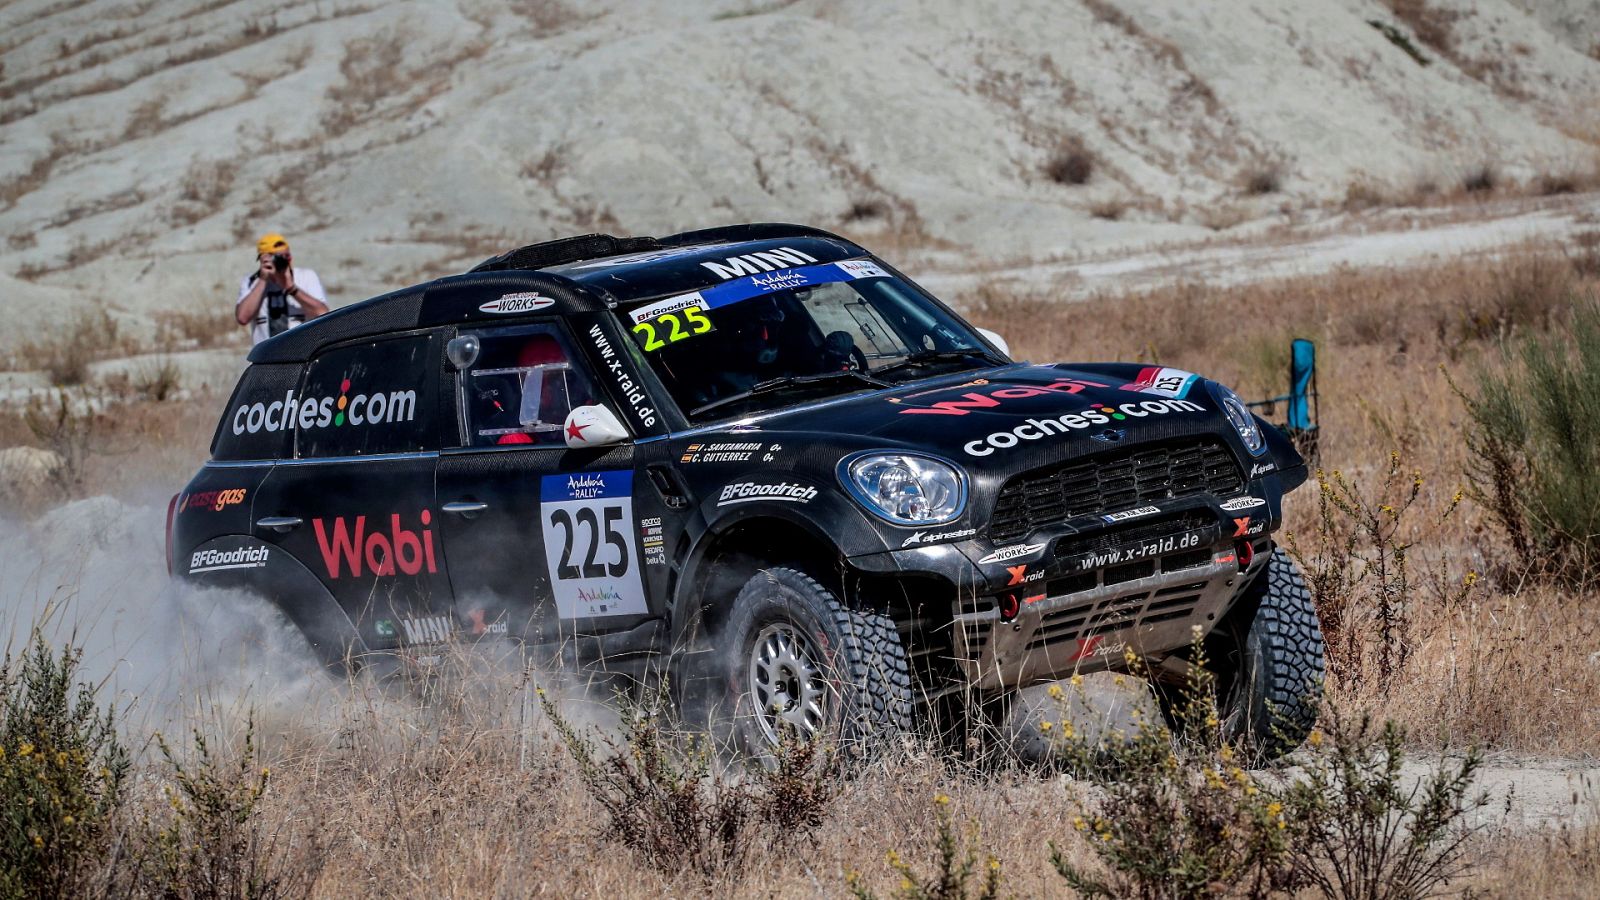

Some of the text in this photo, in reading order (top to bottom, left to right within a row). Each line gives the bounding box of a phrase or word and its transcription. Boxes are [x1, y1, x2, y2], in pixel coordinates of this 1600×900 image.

[701, 247, 819, 280] MINI
[770, 279, 801, 291] RALLY
[498, 299, 541, 314] WORKS
[637, 297, 702, 321] BFGoodrich
[632, 306, 712, 352] 225
[589, 323, 657, 428] www.x-raid.de
[898, 377, 1110, 416] Wabi
[232, 389, 416, 436] coches.com
[963, 398, 1206, 457] coches.com
[703, 452, 753, 462] GUTIERREZ
[575, 488, 598, 498] RALLY
[719, 482, 818, 501] BFGoodrich
[1229, 498, 1255, 510] WORKS
[312, 509, 437, 579] Wabi
[550, 506, 629, 580] 225
[922, 528, 977, 543] alpinestars
[190, 545, 269, 568] BFGoodrich
[996, 547, 1028, 561] WORKS
[1081, 532, 1199, 570] www.x-raid.de
[403, 616, 450, 644] MINI
